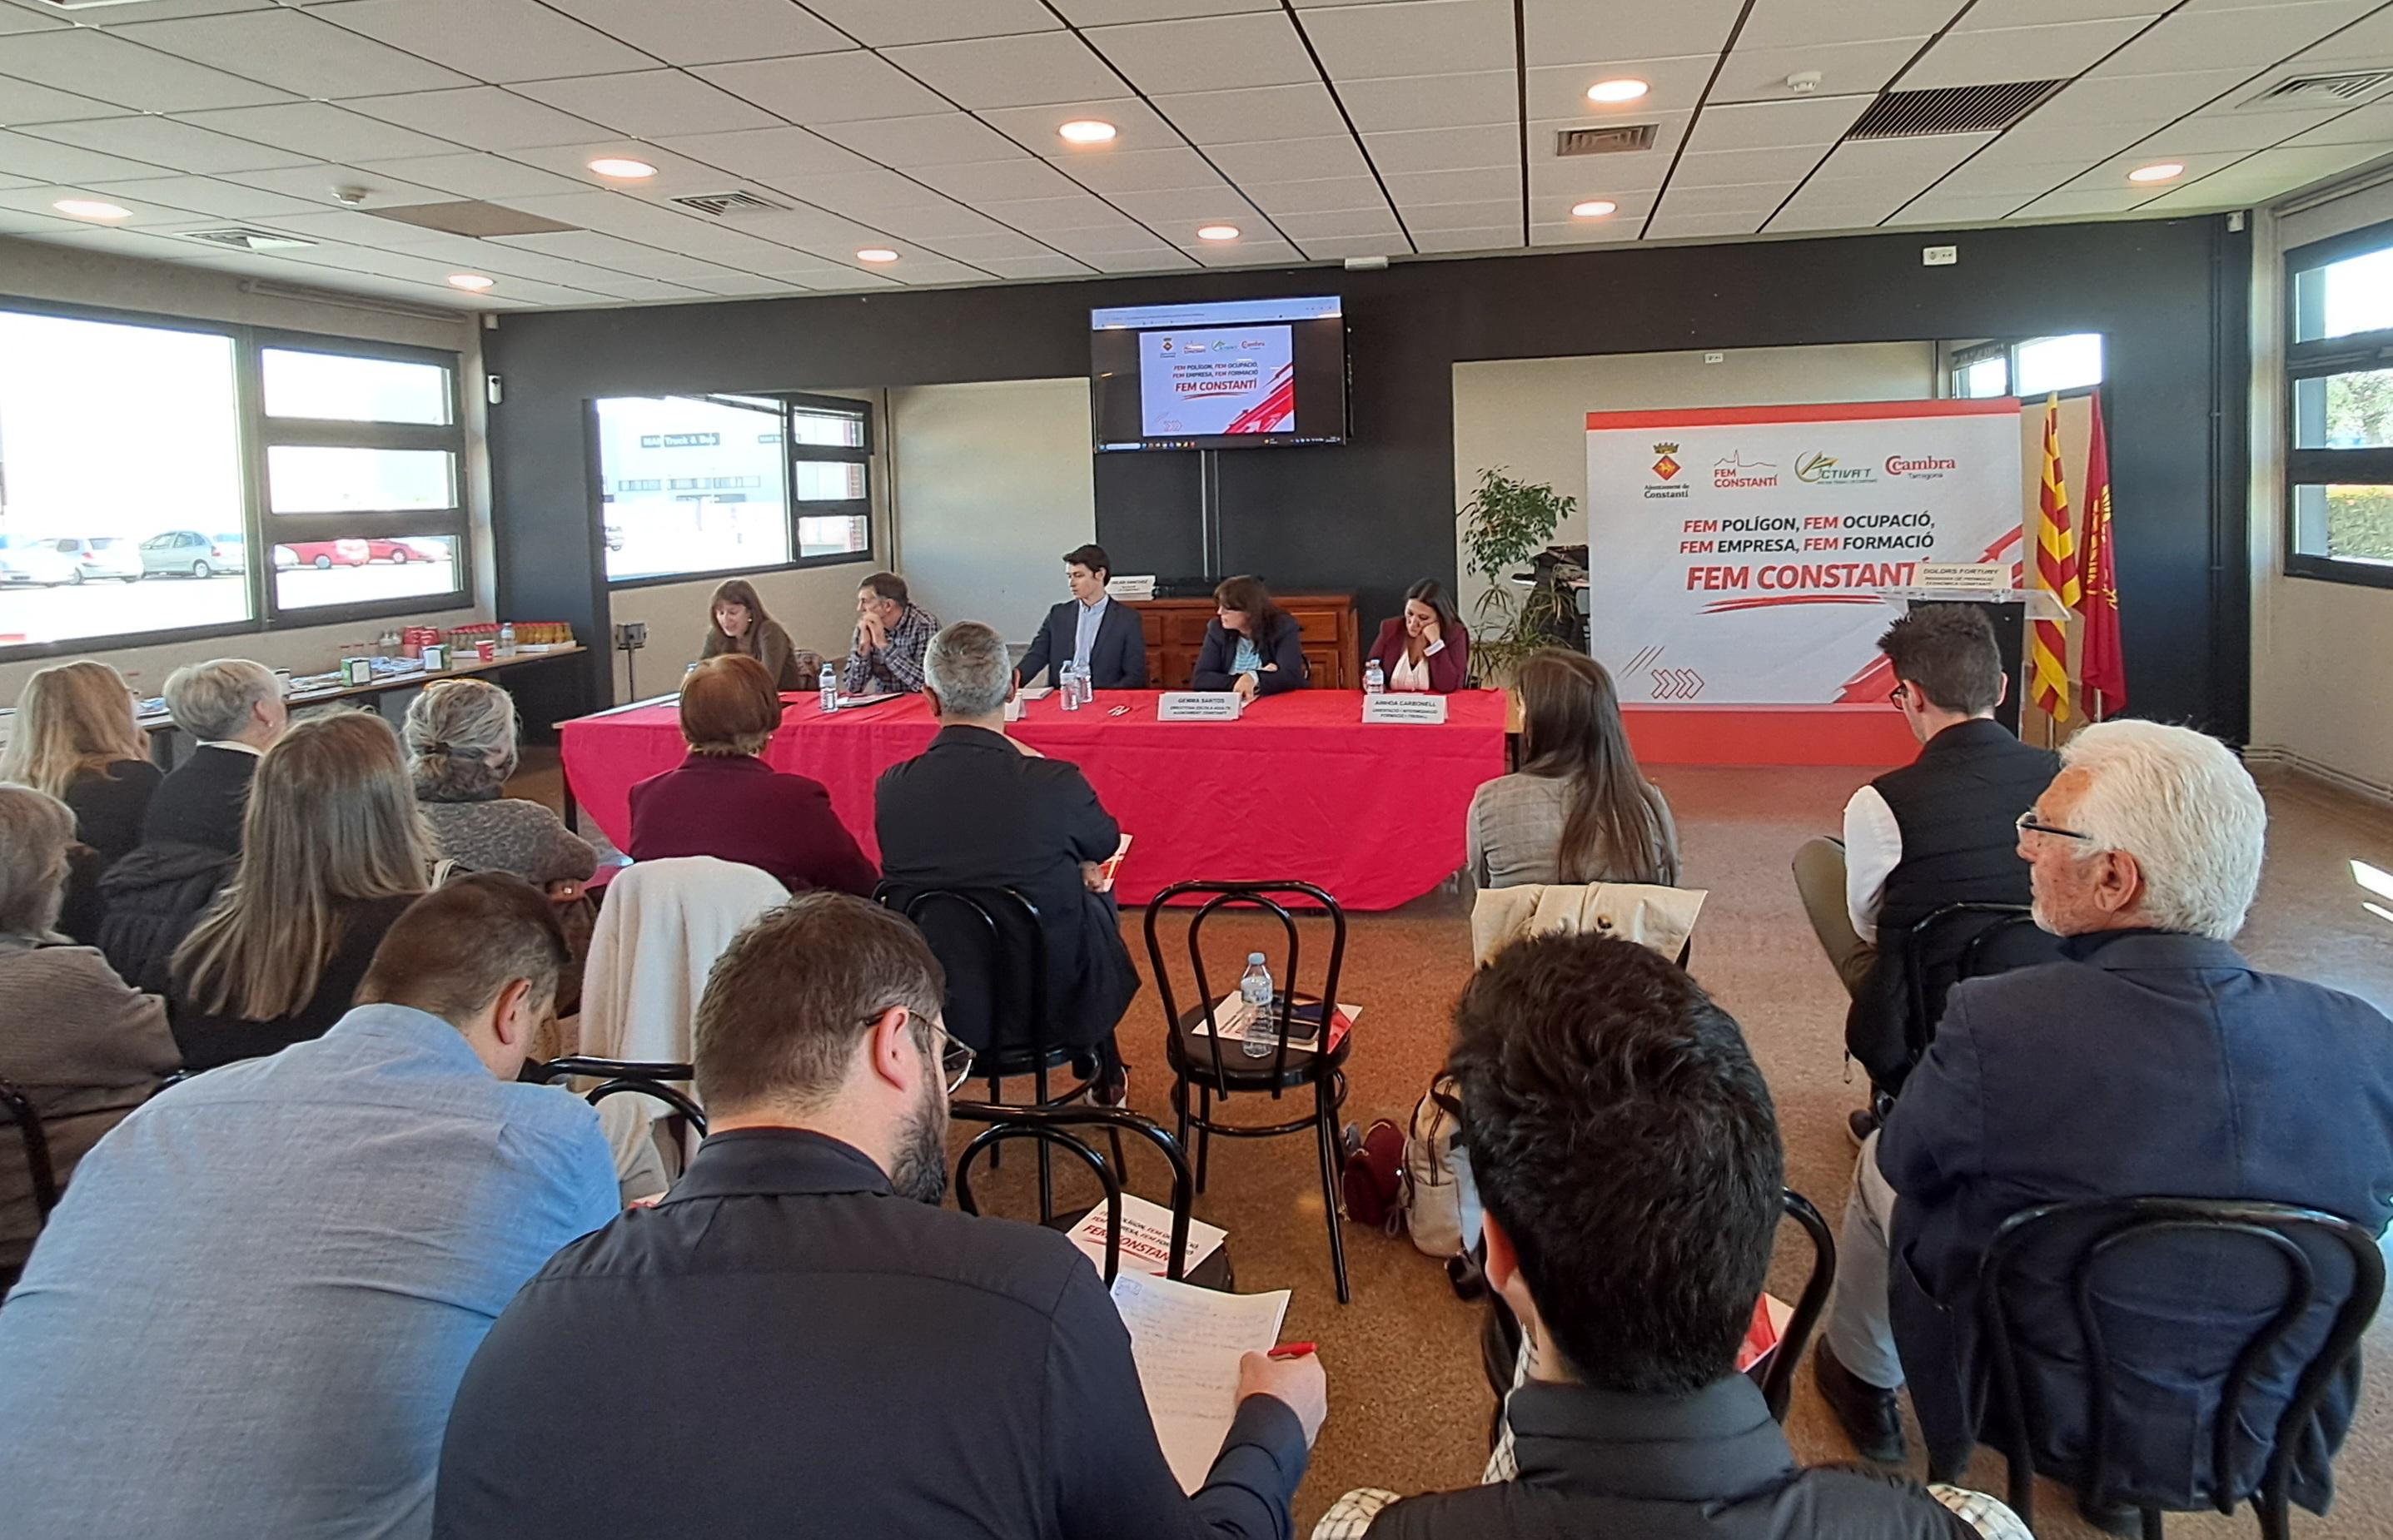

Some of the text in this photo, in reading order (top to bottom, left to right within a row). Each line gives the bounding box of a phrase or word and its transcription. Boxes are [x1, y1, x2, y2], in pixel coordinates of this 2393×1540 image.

[1176, 378, 1257, 392] FEM CONSTANTÍ
[1714, 469, 1736, 479] FEM
[1714, 474, 1778, 489] CONSTANTÍ
[1644, 489, 1689, 499] Constantí
[1683, 510, 1935, 534] FEM POLÍGON, FEM OCUPACIÓ,
[1679, 531, 1934, 554] FEM EMPRESA, FEM FORMACIÓ
[1686, 556, 1930, 591] FEM CONSTANT
